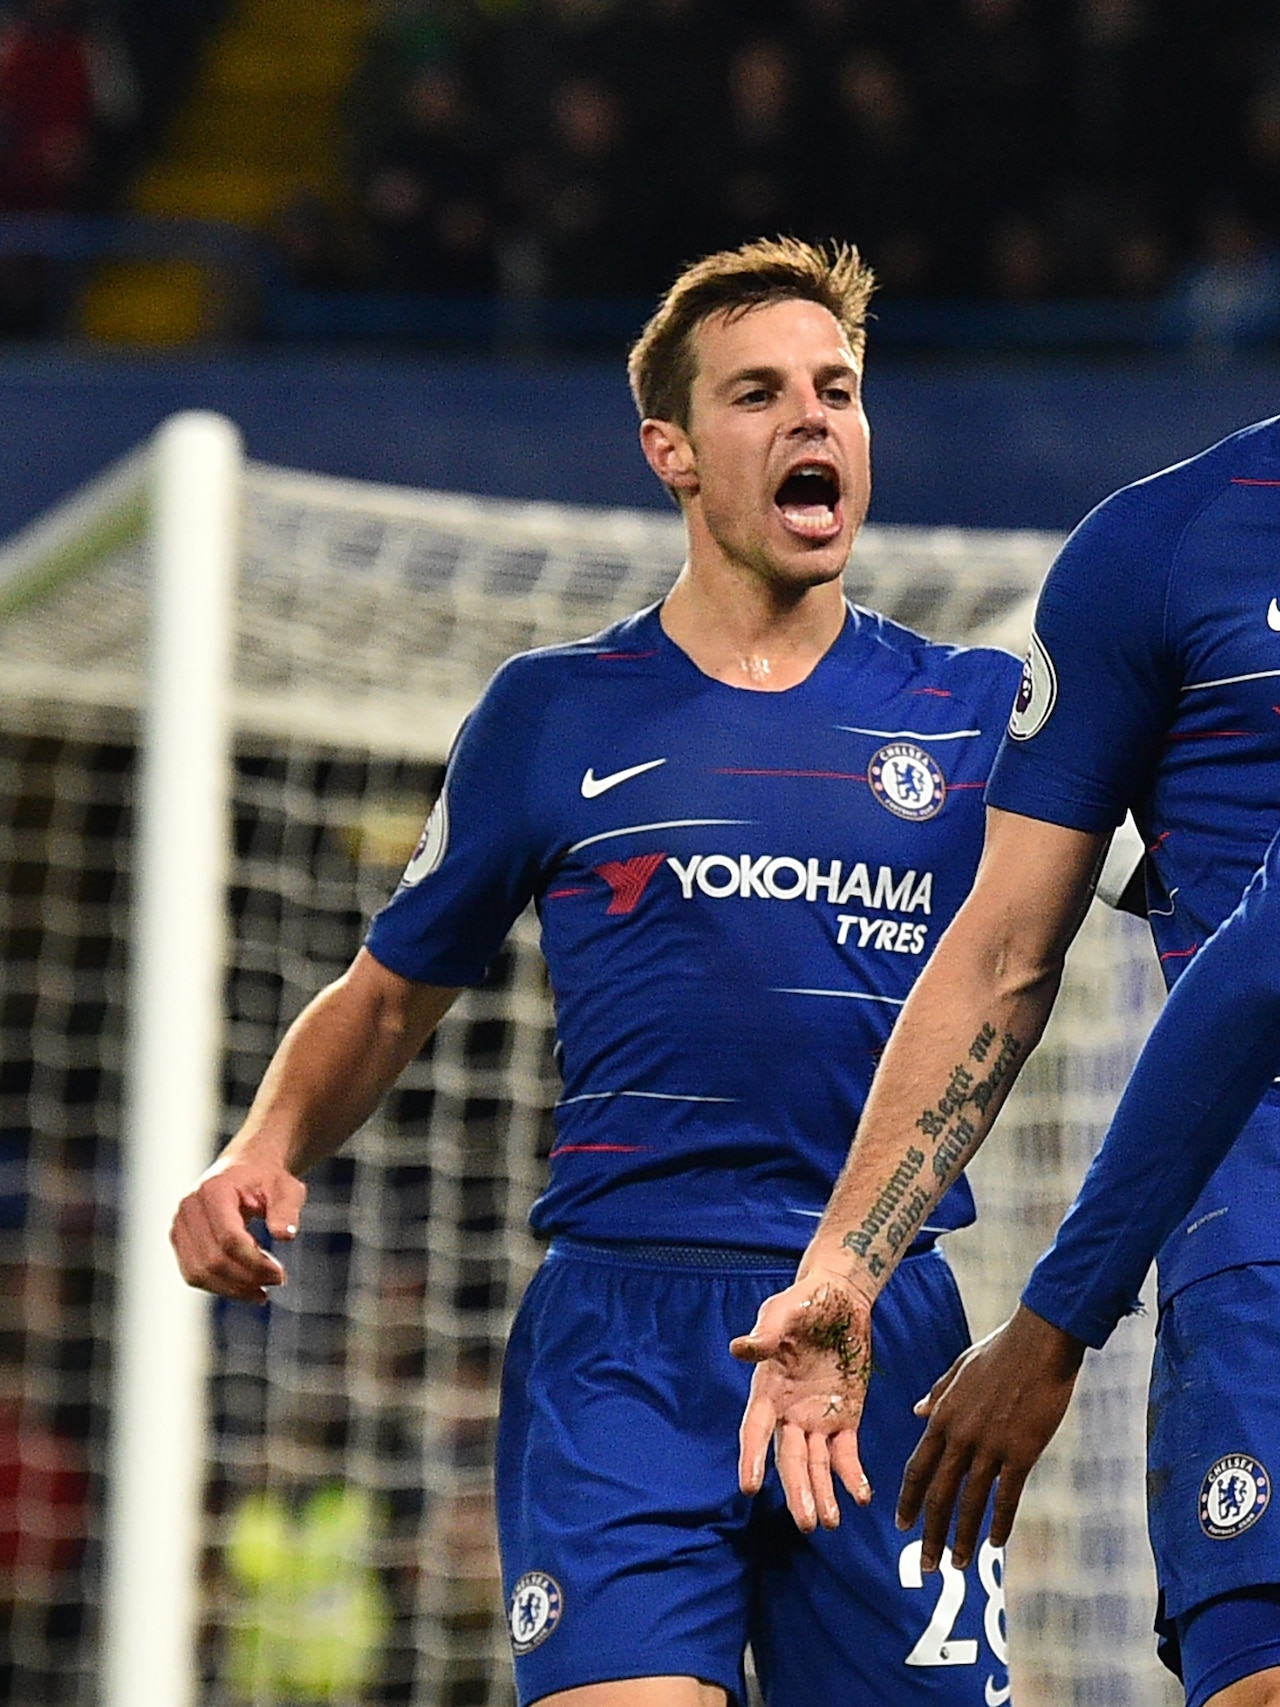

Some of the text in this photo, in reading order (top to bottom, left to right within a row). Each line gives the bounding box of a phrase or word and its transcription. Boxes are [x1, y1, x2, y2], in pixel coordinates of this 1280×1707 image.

[667, 853, 932, 914] YOKOHAMA
[836, 914, 928, 954] TYRES
[969, 1022, 996, 1062] me
[1208, 1457, 1254, 1483] CHELSEA
[898, 1537, 1009, 1666] 28
